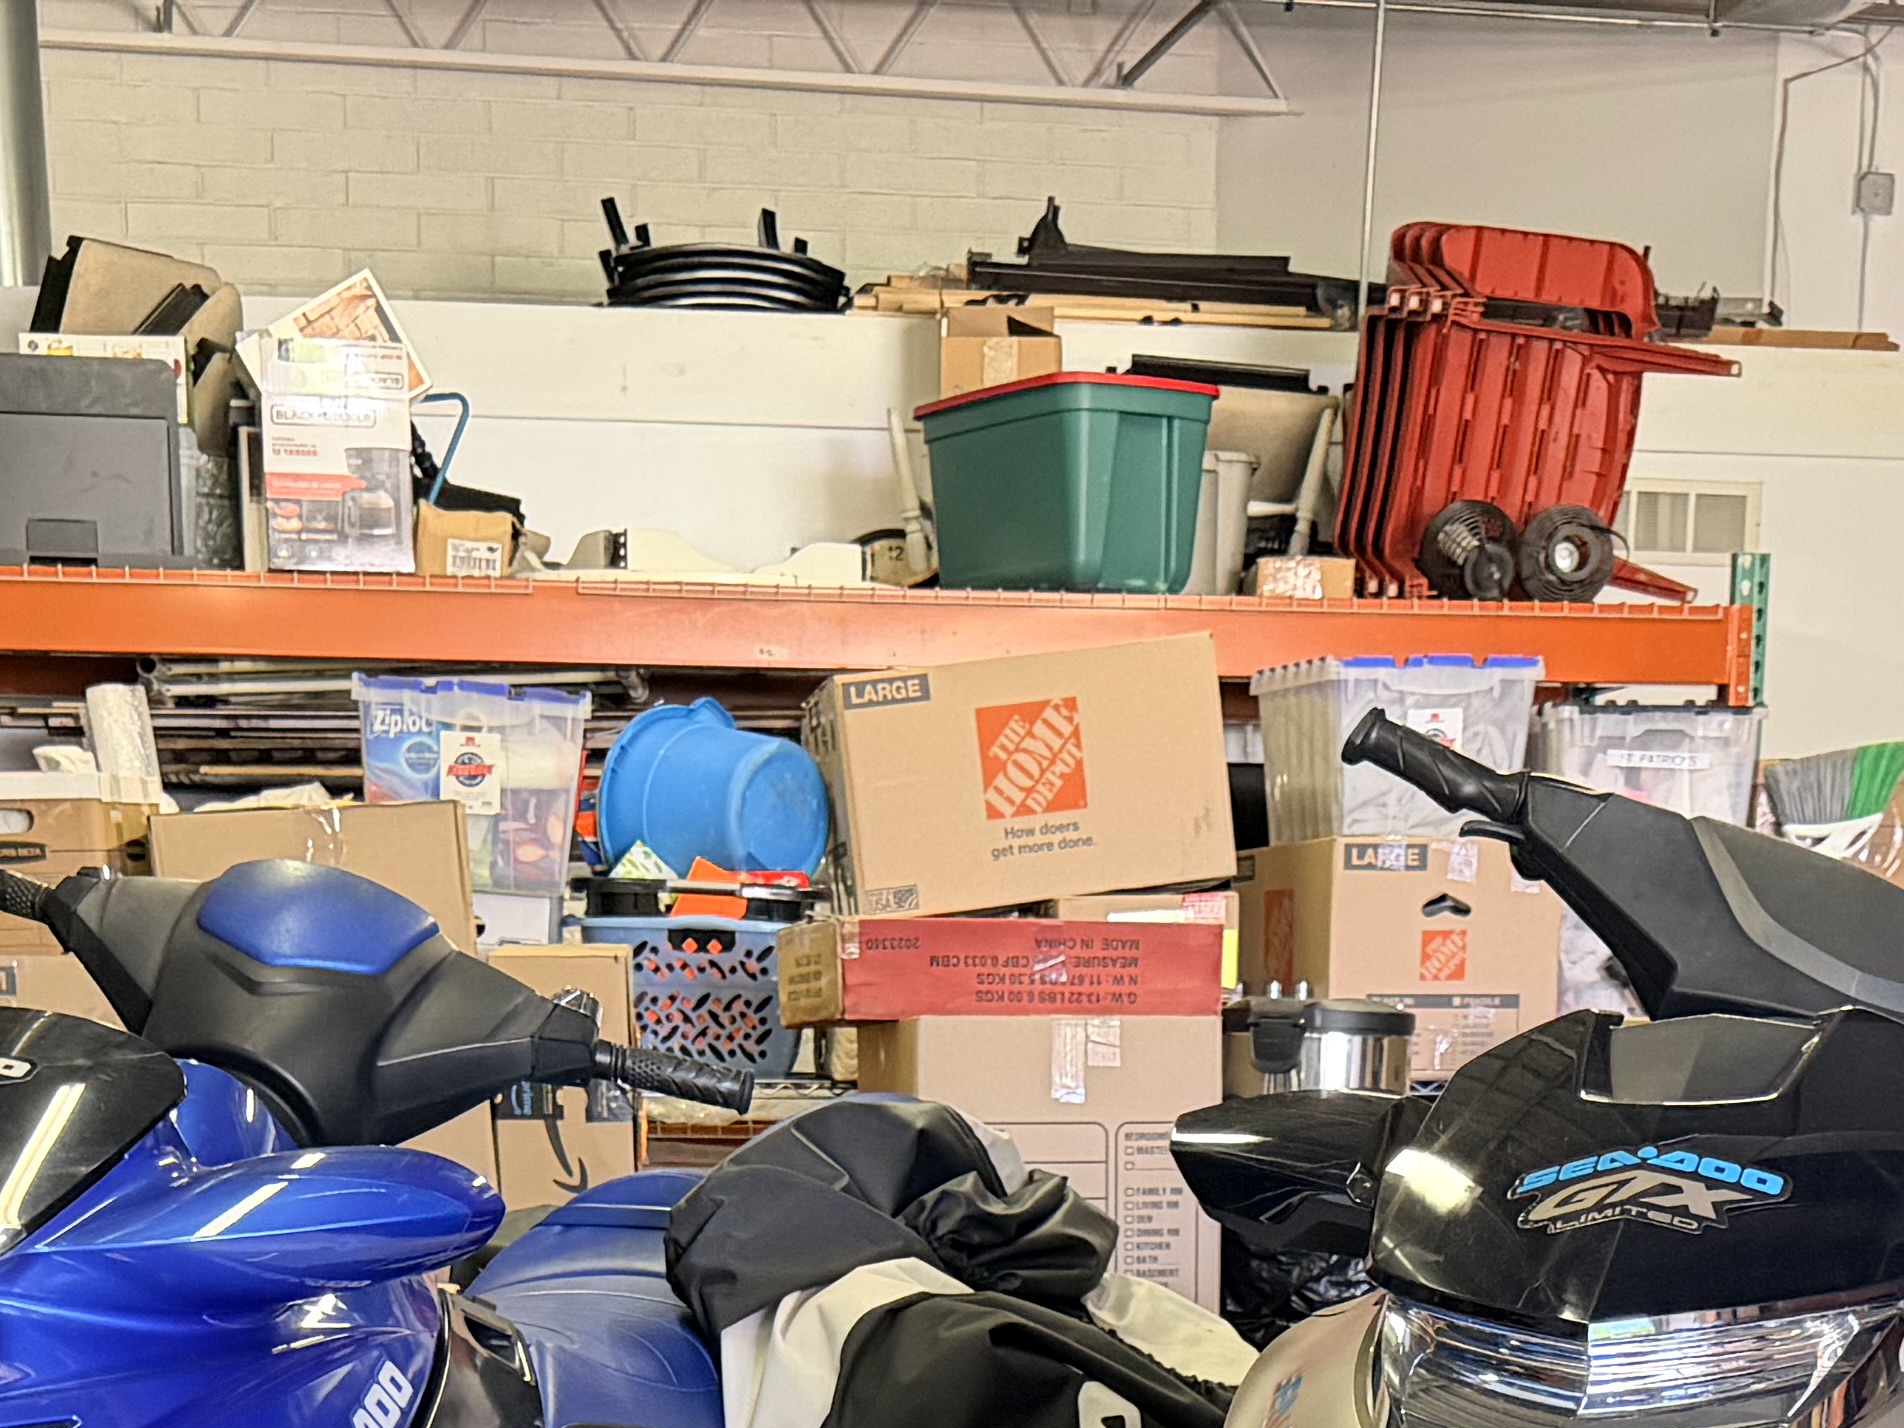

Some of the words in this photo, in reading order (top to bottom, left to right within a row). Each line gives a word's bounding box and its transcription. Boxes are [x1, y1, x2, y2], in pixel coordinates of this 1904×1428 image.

[849, 679, 922, 705] LARGE
[988, 714, 1031, 762] THE
[984, 696, 1081, 819] HOME
[1025, 738, 1083, 814] DEPOT
[1004, 826, 1036, 840] How
[1039, 821, 1080, 835] doers
[991, 844, 1014, 861] get
[1017, 840, 1054, 855] more
[1034, 937, 1077, 950] CHINA
[1080, 938, 1094, 950] IN
[1101, 938, 1140, 951] MADE
[929, 954, 961, 968] CBM
[976, 973, 1007, 985] KGS
[975, 990, 1006, 1003] KGS
[1555, 1205, 1700, 1231] LIMITED
